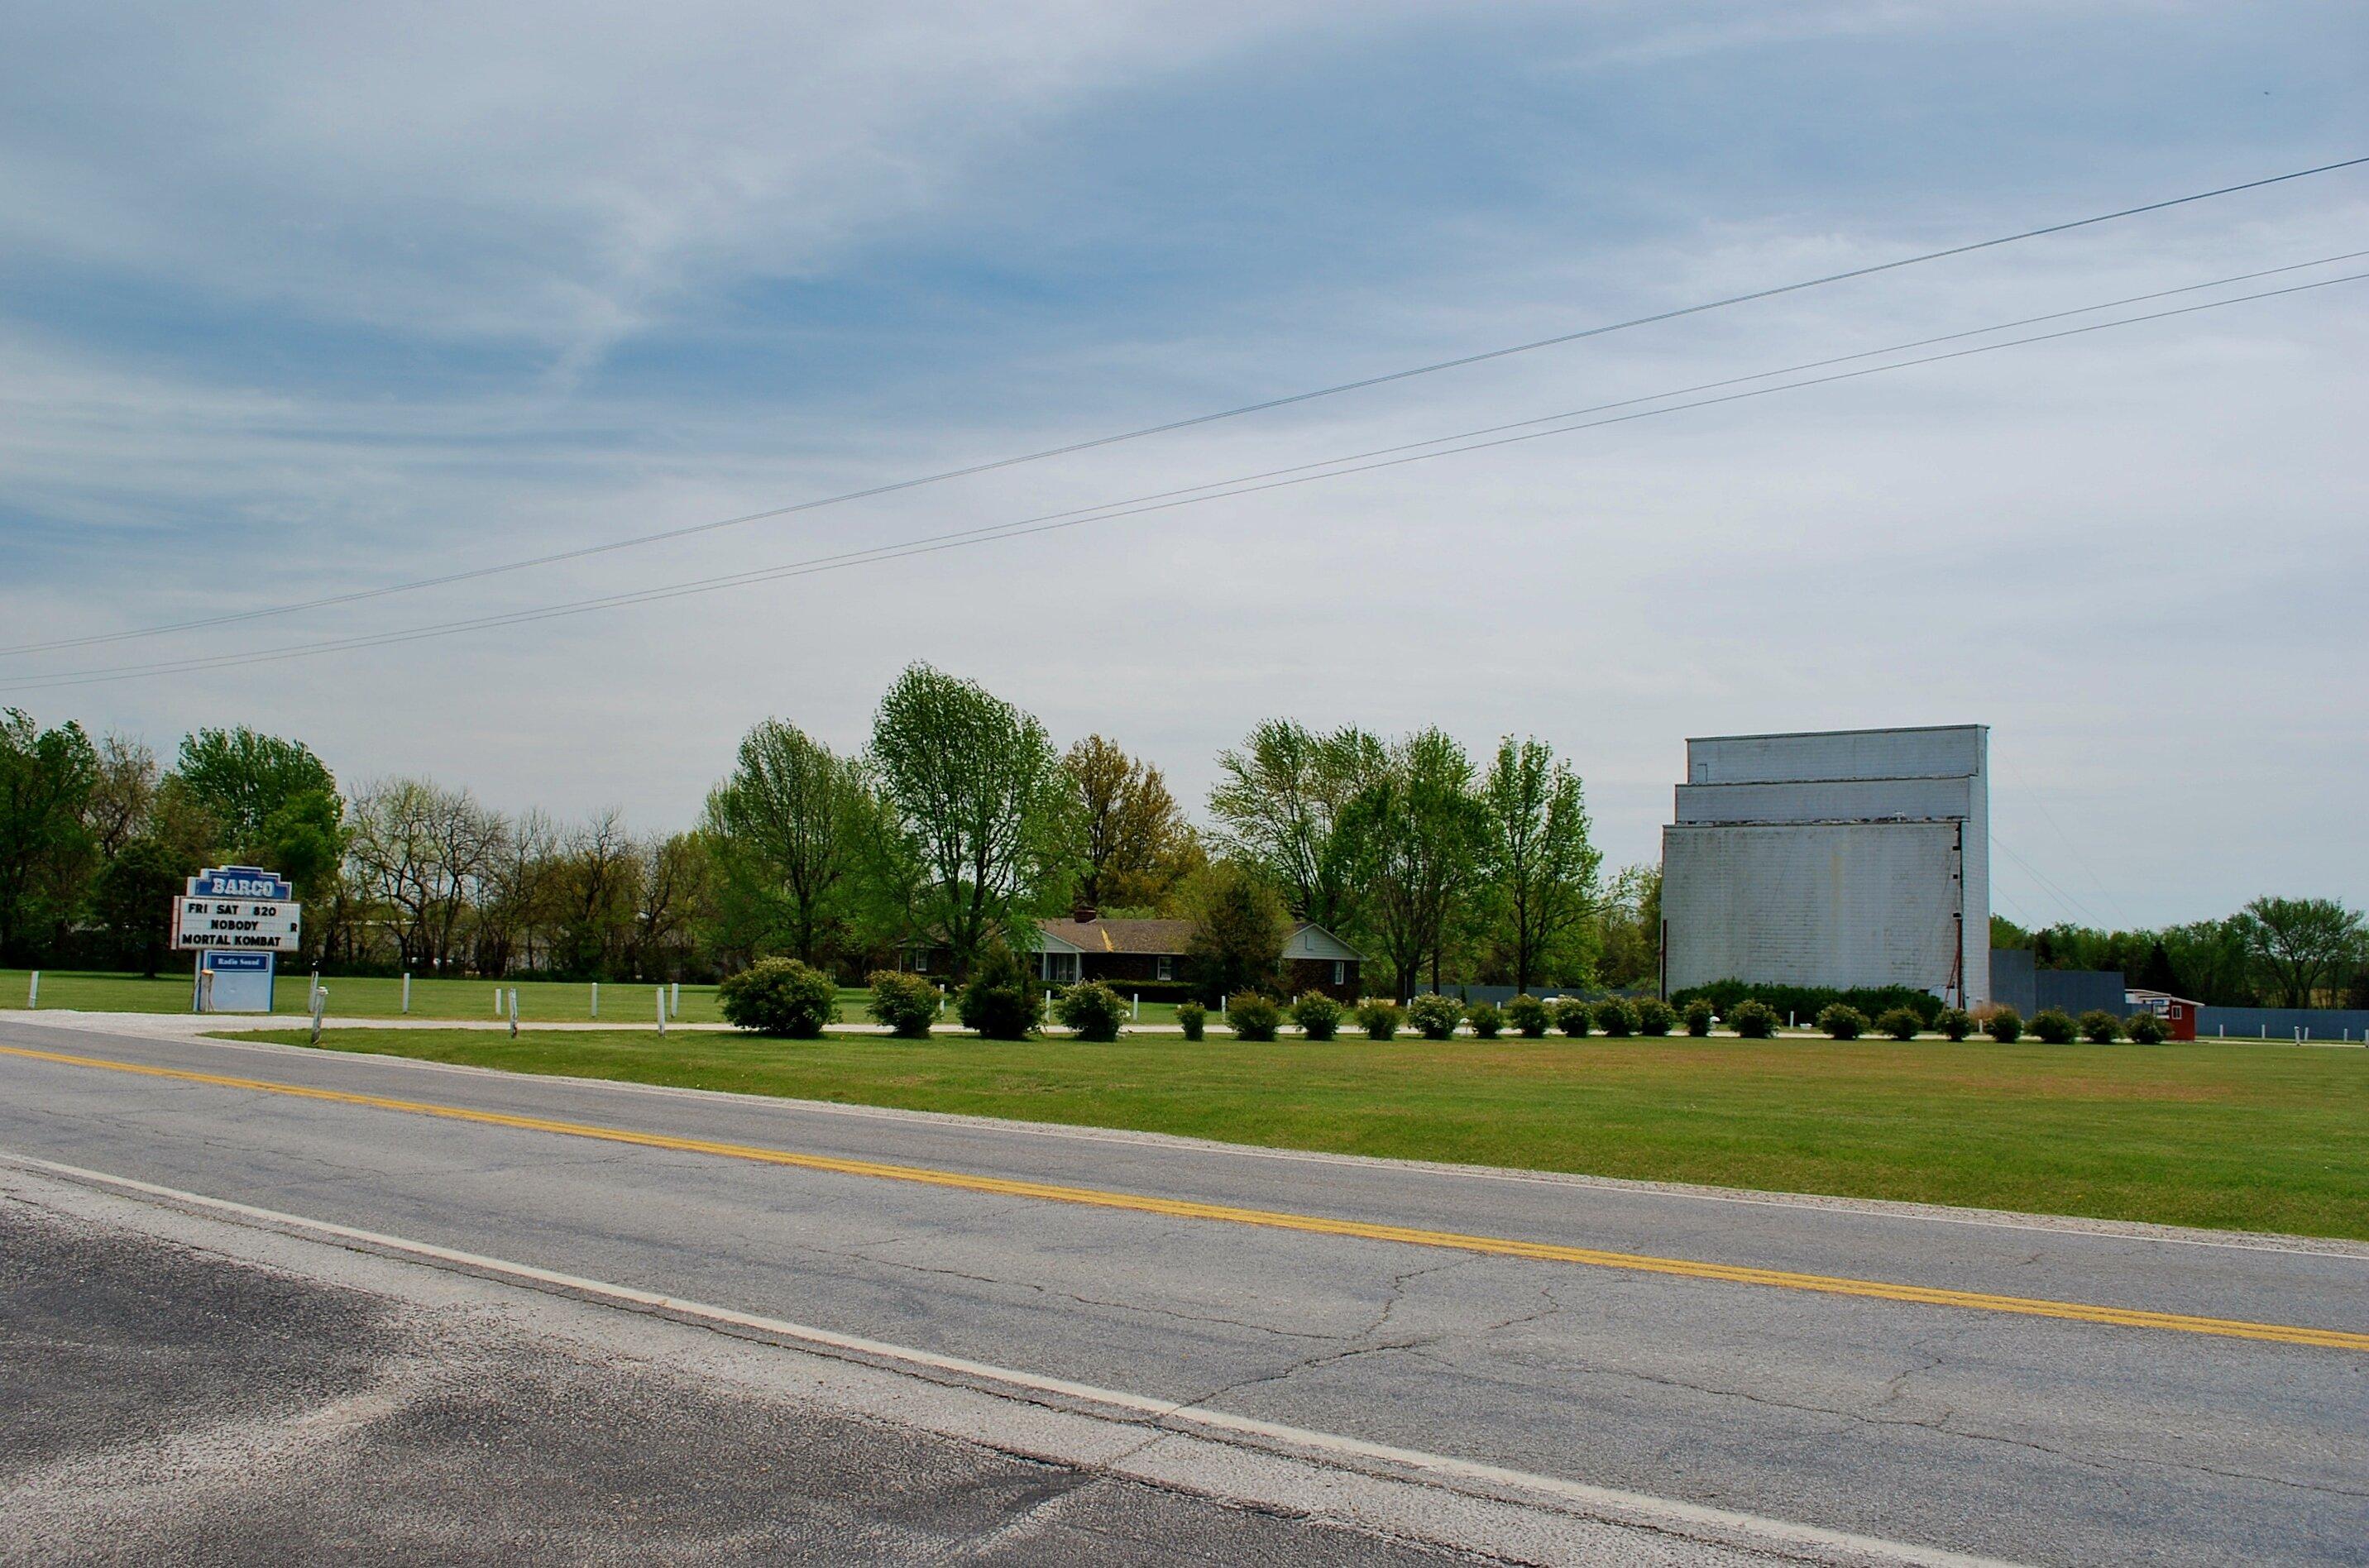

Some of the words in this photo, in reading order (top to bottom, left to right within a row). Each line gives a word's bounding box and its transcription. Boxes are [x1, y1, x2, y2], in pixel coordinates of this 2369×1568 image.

[212, 877, 275, 896] BARCO
[188, 903, 208, 913] FRI
[216, 905, 239, 915] SAT
[253, 906, 276, 916] 820
[211, 920, 259, 930] NOBODY
[290, 923, 298, 932] R
[182, 934, 231, 945] MORTAL
[234, 935, 281, 946] KOMBAT
